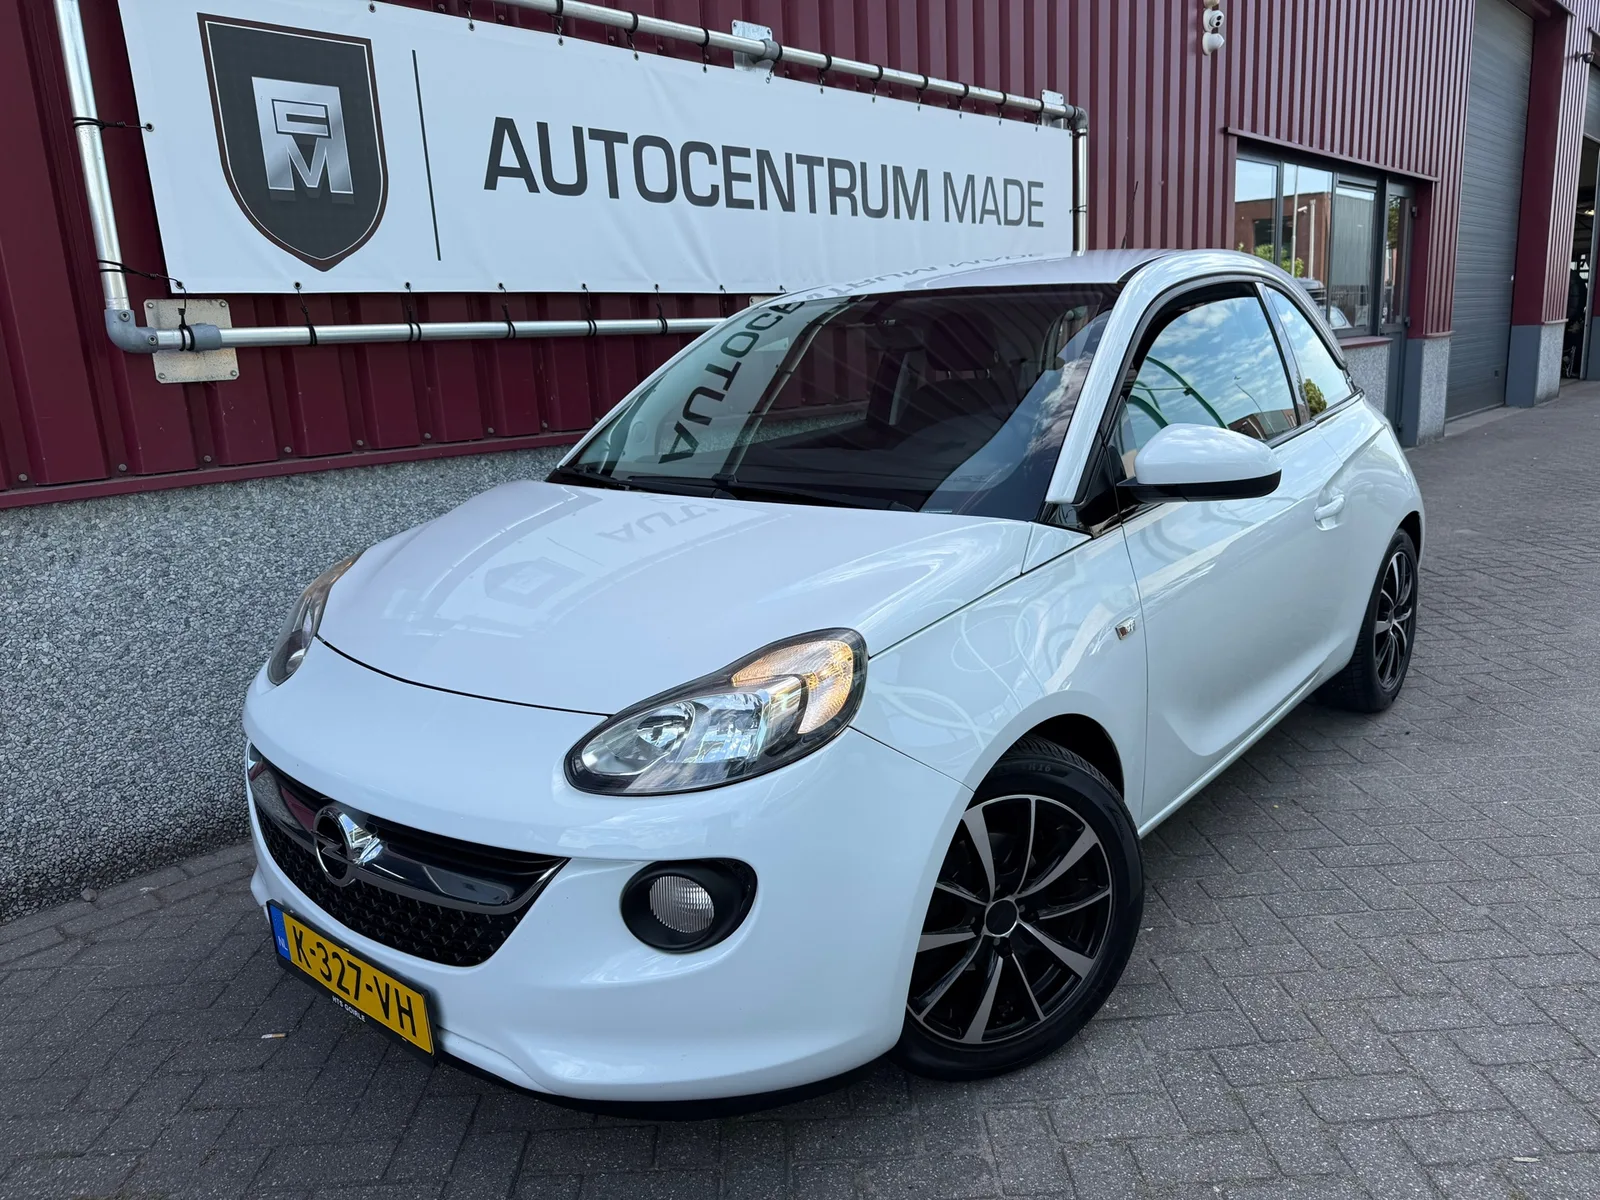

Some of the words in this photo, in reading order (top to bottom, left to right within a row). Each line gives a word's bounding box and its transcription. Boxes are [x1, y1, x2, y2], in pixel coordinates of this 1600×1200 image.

[483, 116, 930, 222] AUTOCENTRUM
[943, 171, 1044, 228] MADE
[278, 936, 288, 951] NL
[292, 925, 417, 1037] K-327-VH
